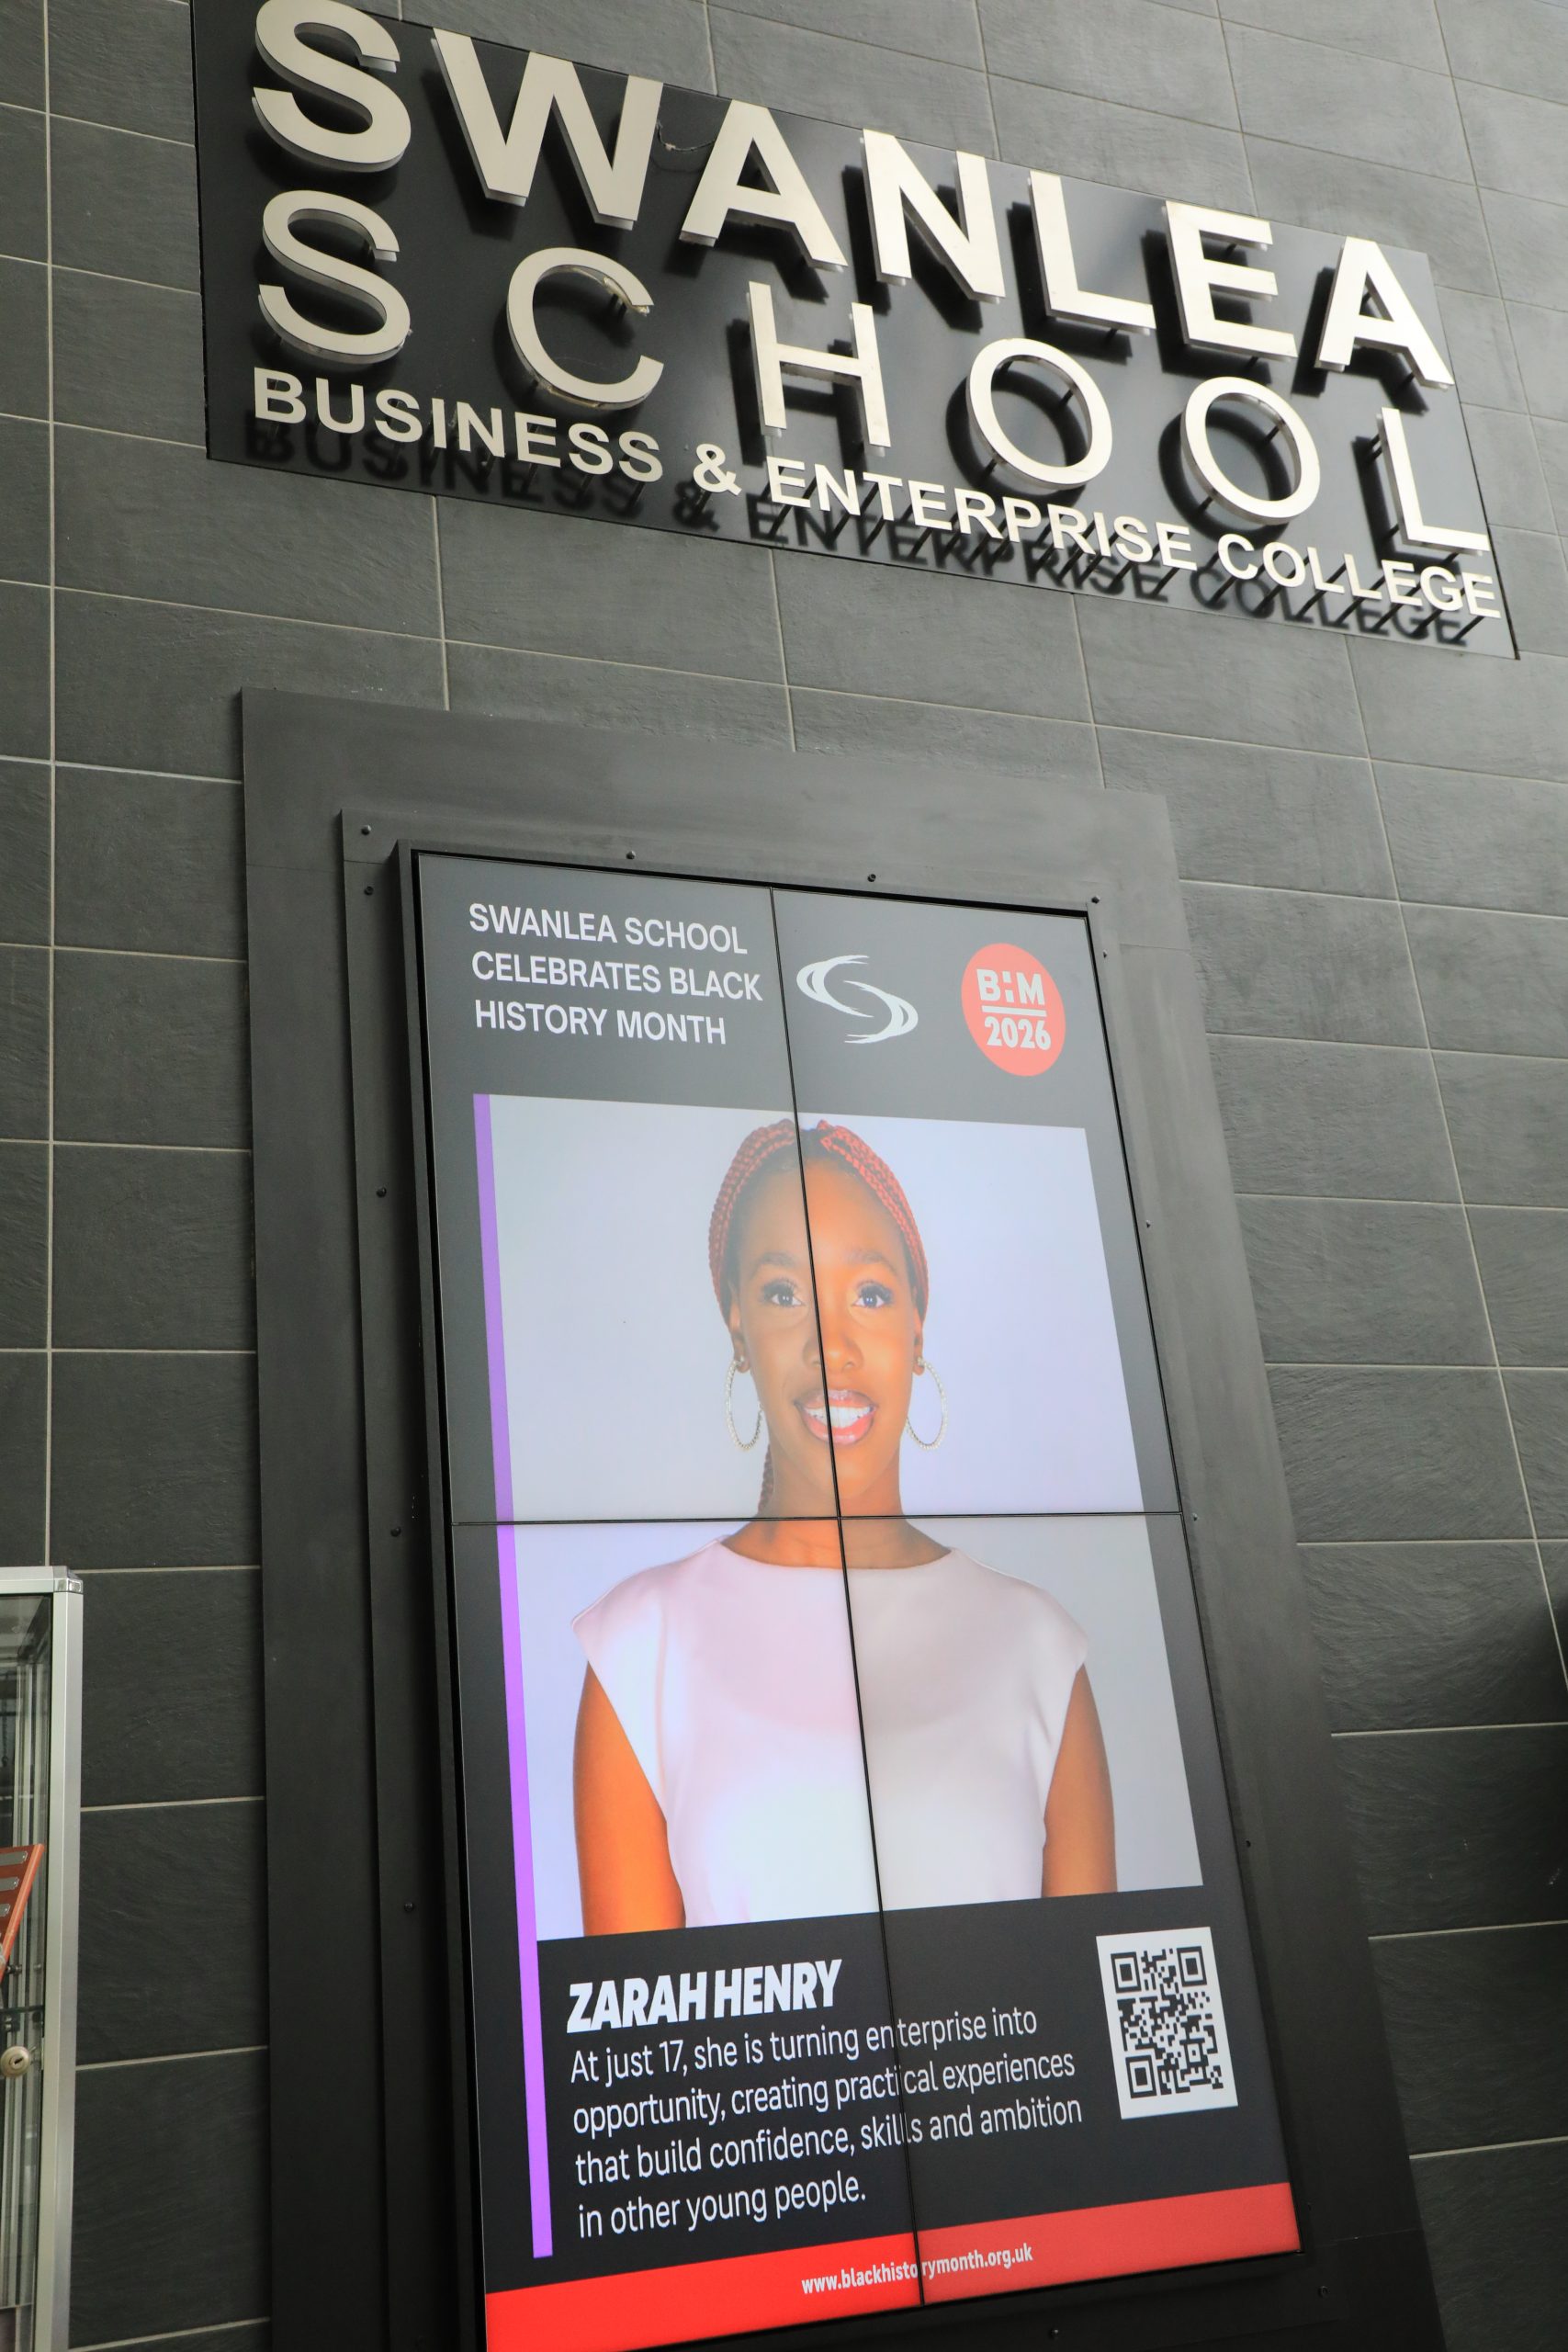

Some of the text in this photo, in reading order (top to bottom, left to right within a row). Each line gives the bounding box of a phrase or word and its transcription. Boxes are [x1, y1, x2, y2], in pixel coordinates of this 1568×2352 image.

[252, 0, 1454, 390] SWANLEA
[258, 190, 1490, 556] SCHOOL
[254, 368, 1502, 619] BUSINESS & ENTERPRISE COLLEGE
[468, 903, 748, 955] SWANLEA SCHOOL
[472, 951, 763, 1001] CELEBRATES BLACK
[474, 1000, 726, 1045] HISTORY MONTH
[984, 1016, 1051, 1050] 2026
[567, 1959, 843, 2033] ZARAH HENRY
[570, 2007, 1037, 2087] At just 17, she is turning enterprise into
[573, 2052, 1076, 2140] opportunity, creating practical experiences
[575, 2096, 1082, 2186] that build confidence, skills and ambition
[579, 2170, 866, 2238] in other young people.
[801, 2242, 1033, 2294] www.blackhistorymonth.org.uk
